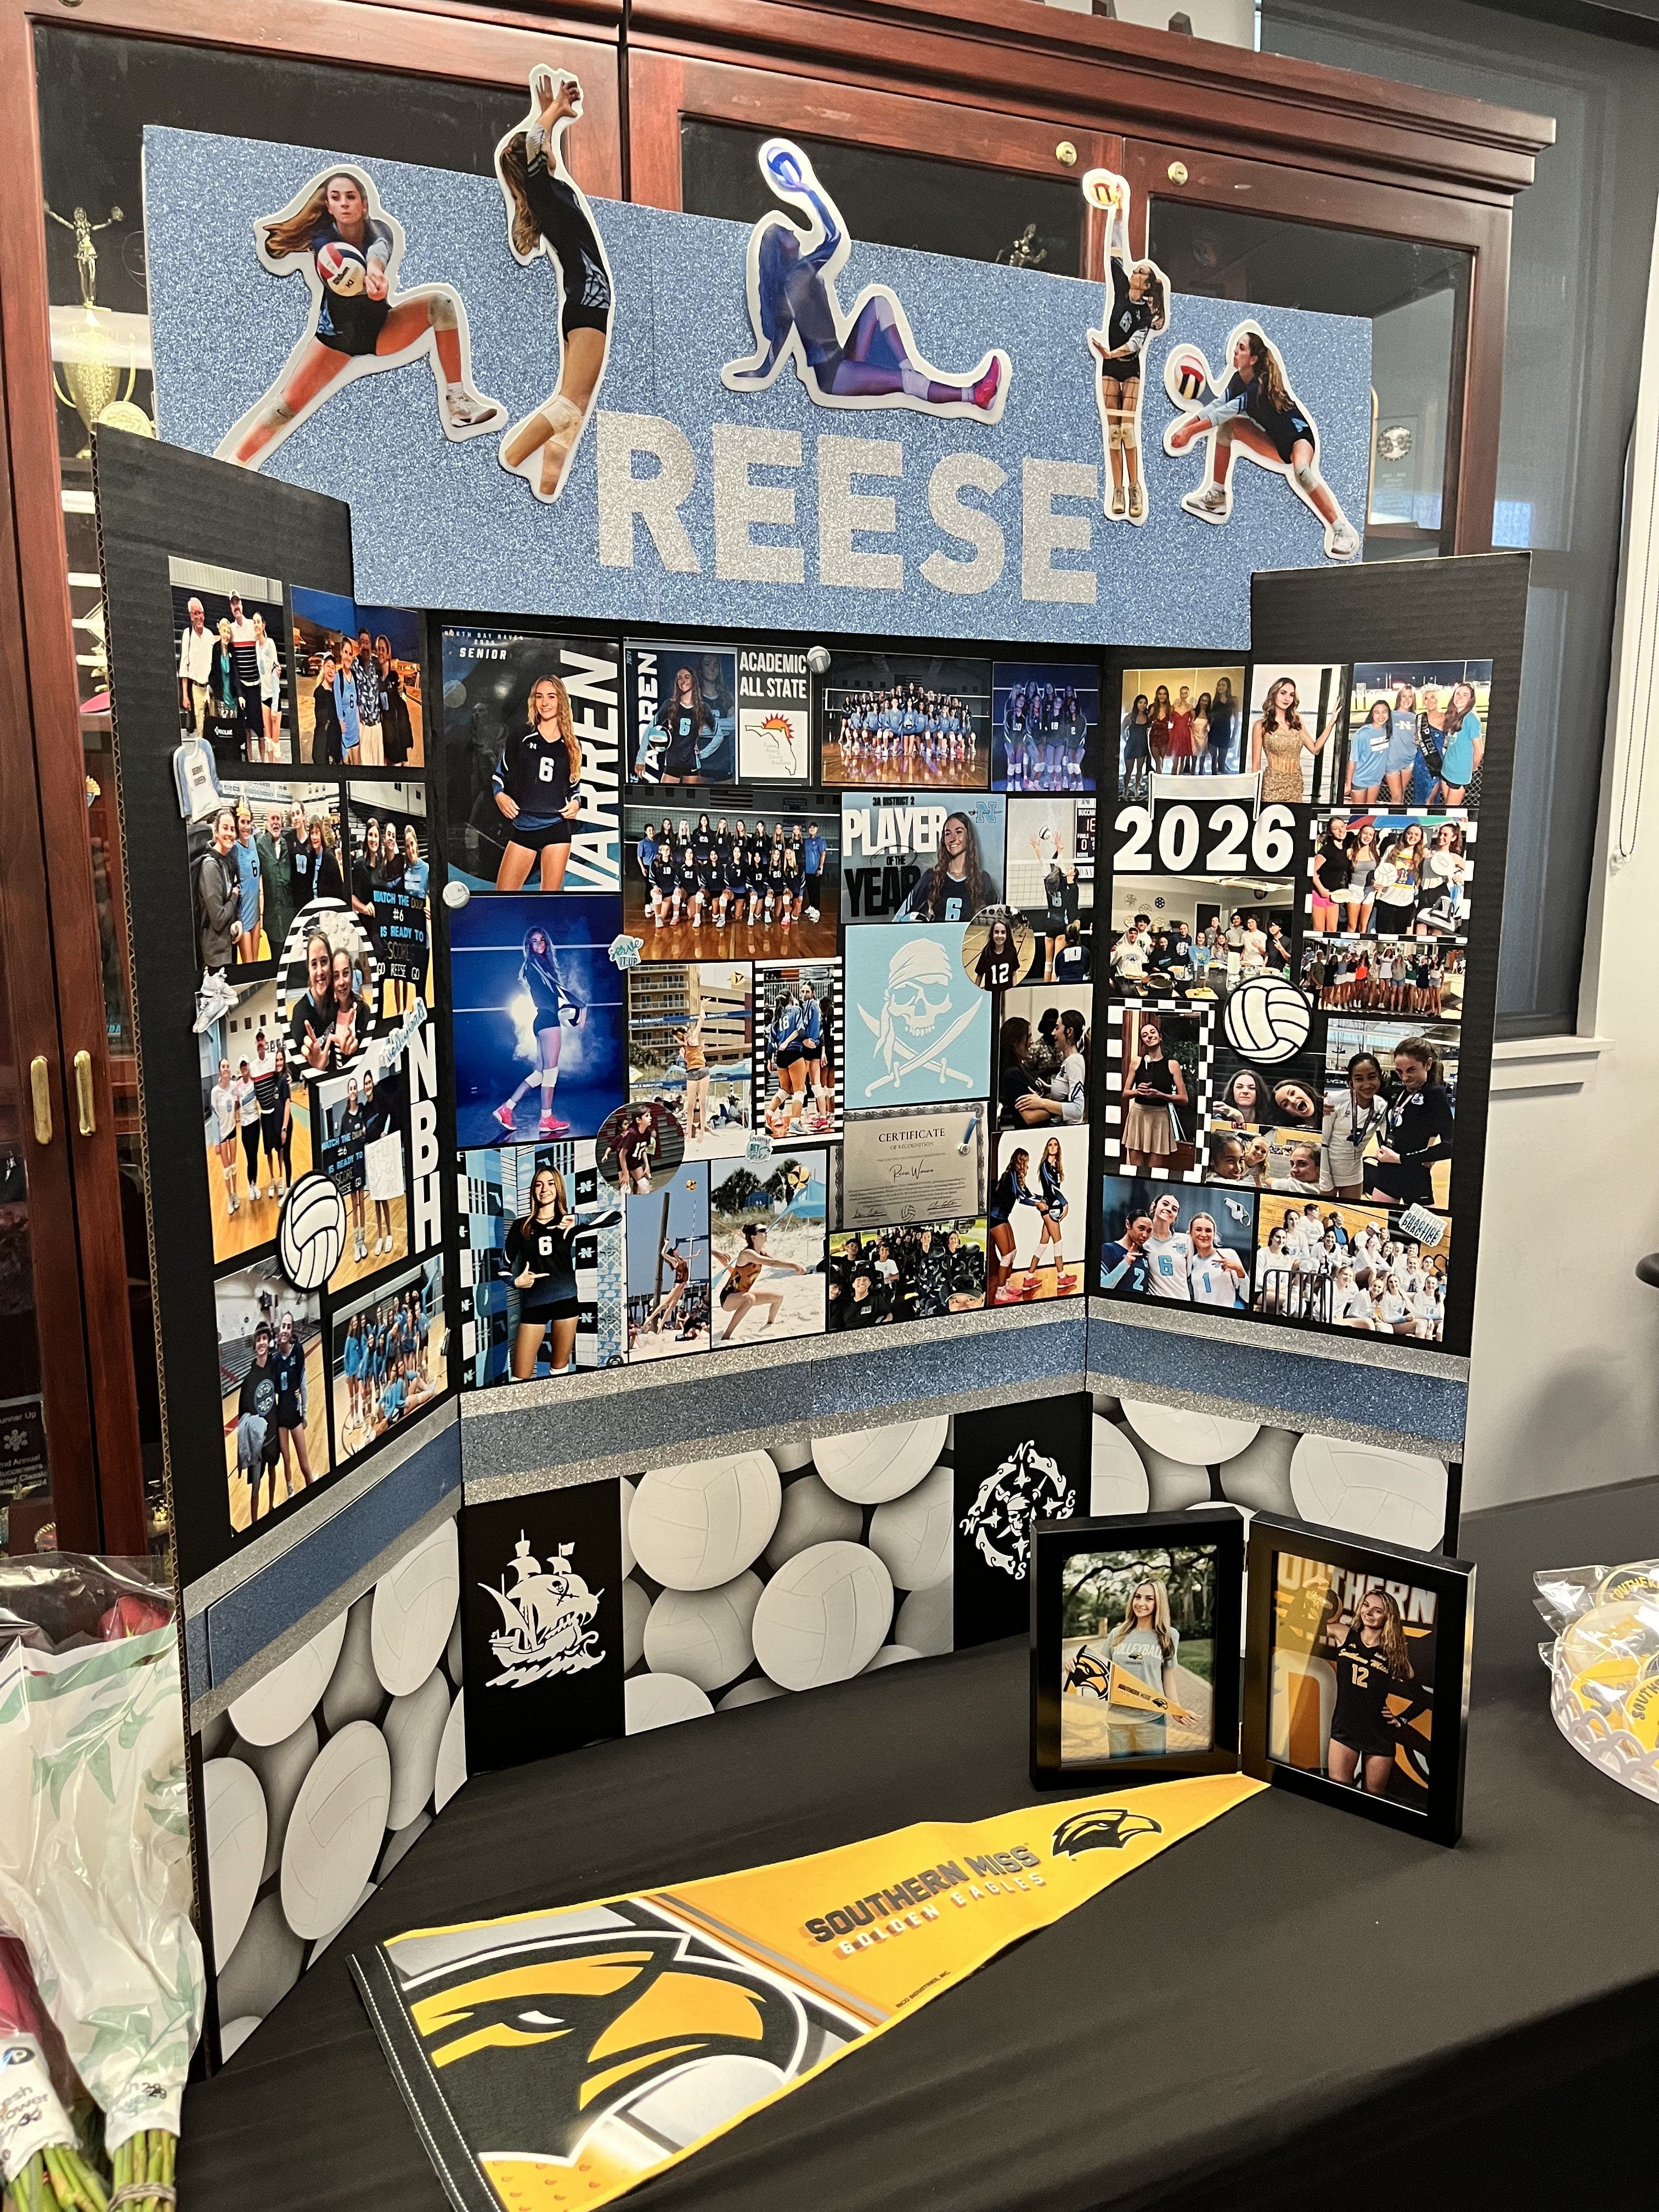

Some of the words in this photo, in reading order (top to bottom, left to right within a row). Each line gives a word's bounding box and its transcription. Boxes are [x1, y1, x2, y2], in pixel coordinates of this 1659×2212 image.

[596, 410, 1098, 605] REESE
[459, 647, 507, 660] SENIOR
[740, 651, 806, 674] ACADEMIC
[740, 676, 764, 697] ALL
[767, 679, 807, 699] STATE
[349, 694, 354, 709] 6
[679, 718, 691, 736] 6
[1399, 720, 1412, 730] N
[1425, 737, 1437, 754] TEN
[539, 757, 555, 782] 6
[873, 797, 881, 806] 3A
[883, 797, 909, 806] DISTRICT
[911, 797, 915, 805] 2
[977, 802, 996, 823] N
[842, 806, 948, 857] PLAYER
[1113, 804, 1296, 872] 2026
[251, 860, 258, 878] 6
[887, 856, 893, 866] OF
[894, 855, 906, 865] THE
[373, 890, 396, 904] WATCH
[398, 895, 410, 907] THE
[393, 908, 404, 922] #6
[946, 898, 962, 921] 6
[380, 926, 387, 938] IS
[390, 926, 412, 939] READY
[414, 929, 424, 943] TO
[387, 941, 410, 961] SCORE
[1063, 946, 1082, 962] 10
[376, 962, 386, 975] GO
[391, 963, 407, 978] REESE
[411, 967, 420, 980] GO
[991, 964, 1009, 984] 12
[779, 1014, 790, 1032] 18
[878, 1128, 945, 1142] CERTIFICATE
[337, 1154, 354, 1170] READY
[580, 1180, 592, 1193] N
[1401, 1219, 1437, 1246] PRACTICE
[1406, 1212, 1441, 1236] PRACTICE
[538, 1235, 552, 1256] 6
[580, 1247, 593, 1259] N
[1158, 1255, 1173, 1276] 6
[1132, 1267, 1145, 1291] 2
[1202, 1272, 1211, 1293] 1
[581, 1312, 592, 1323] N
[0, 1414, 22, 1424] unner
[13, 1454, 41, 1466] Annual
[1008, 1440, 1035, 1463] N
[1065, 1489, 1076, 1507] E
[960, 1517, 980, 1536] W
[1014, 1562, 1027, 1580] S
[1351, 1663, 1369, 1689] 12
[805, 1860, 969, 1943] SOUTHERN
[963, 1845, 1041, 1877] MISS
[838, 1904, 939, 1955] GOLDEN
[956, 1872, 1045, 1906] EAGLES
